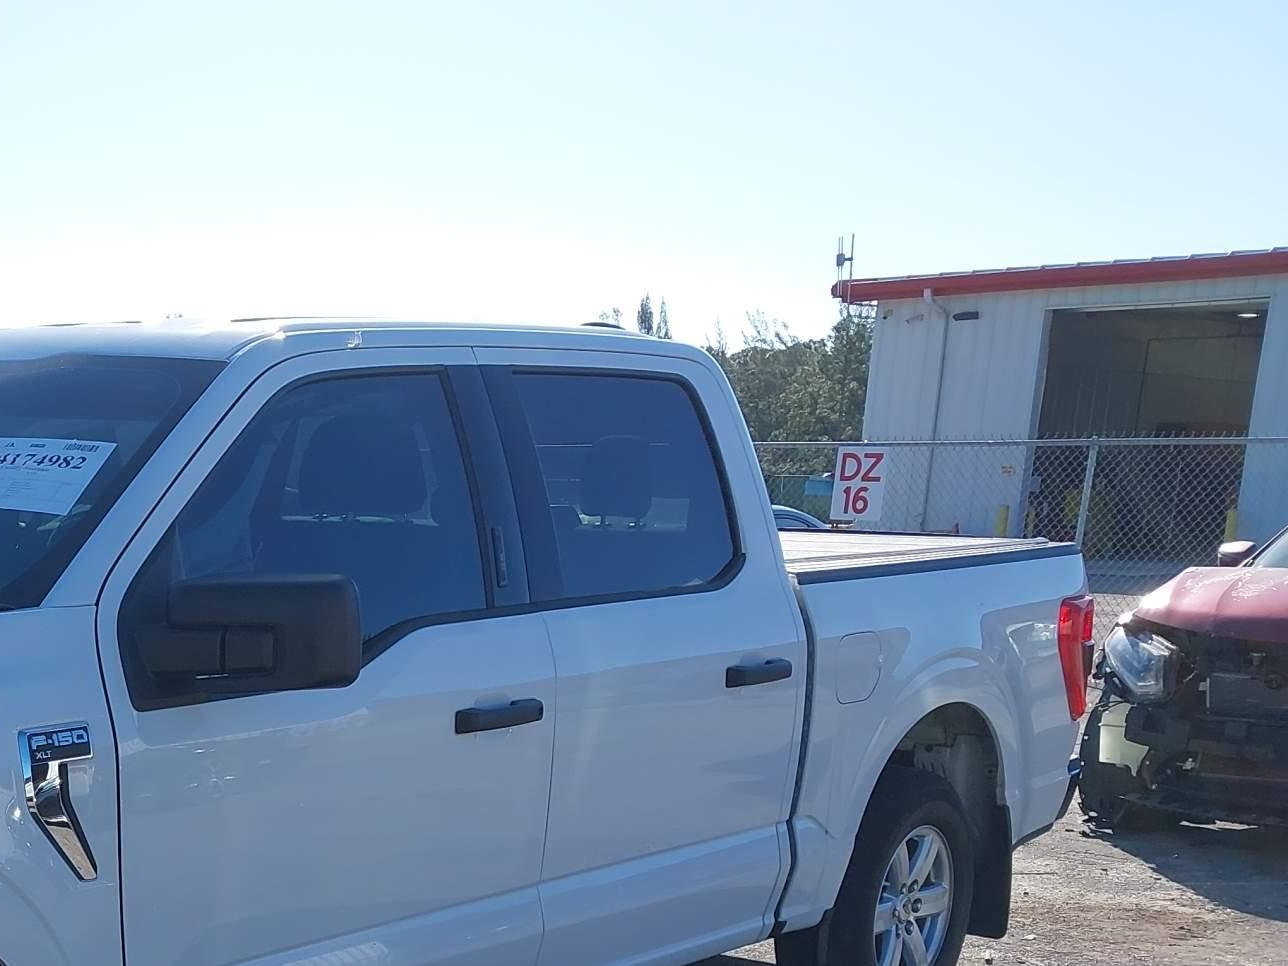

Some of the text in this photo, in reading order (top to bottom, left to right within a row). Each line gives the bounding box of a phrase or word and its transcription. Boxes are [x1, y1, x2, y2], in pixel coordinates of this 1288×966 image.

[839, 452, 884, 482] DZ
[843, 486, 869, 514] 16
[35, 750, 53, 760] XLT
